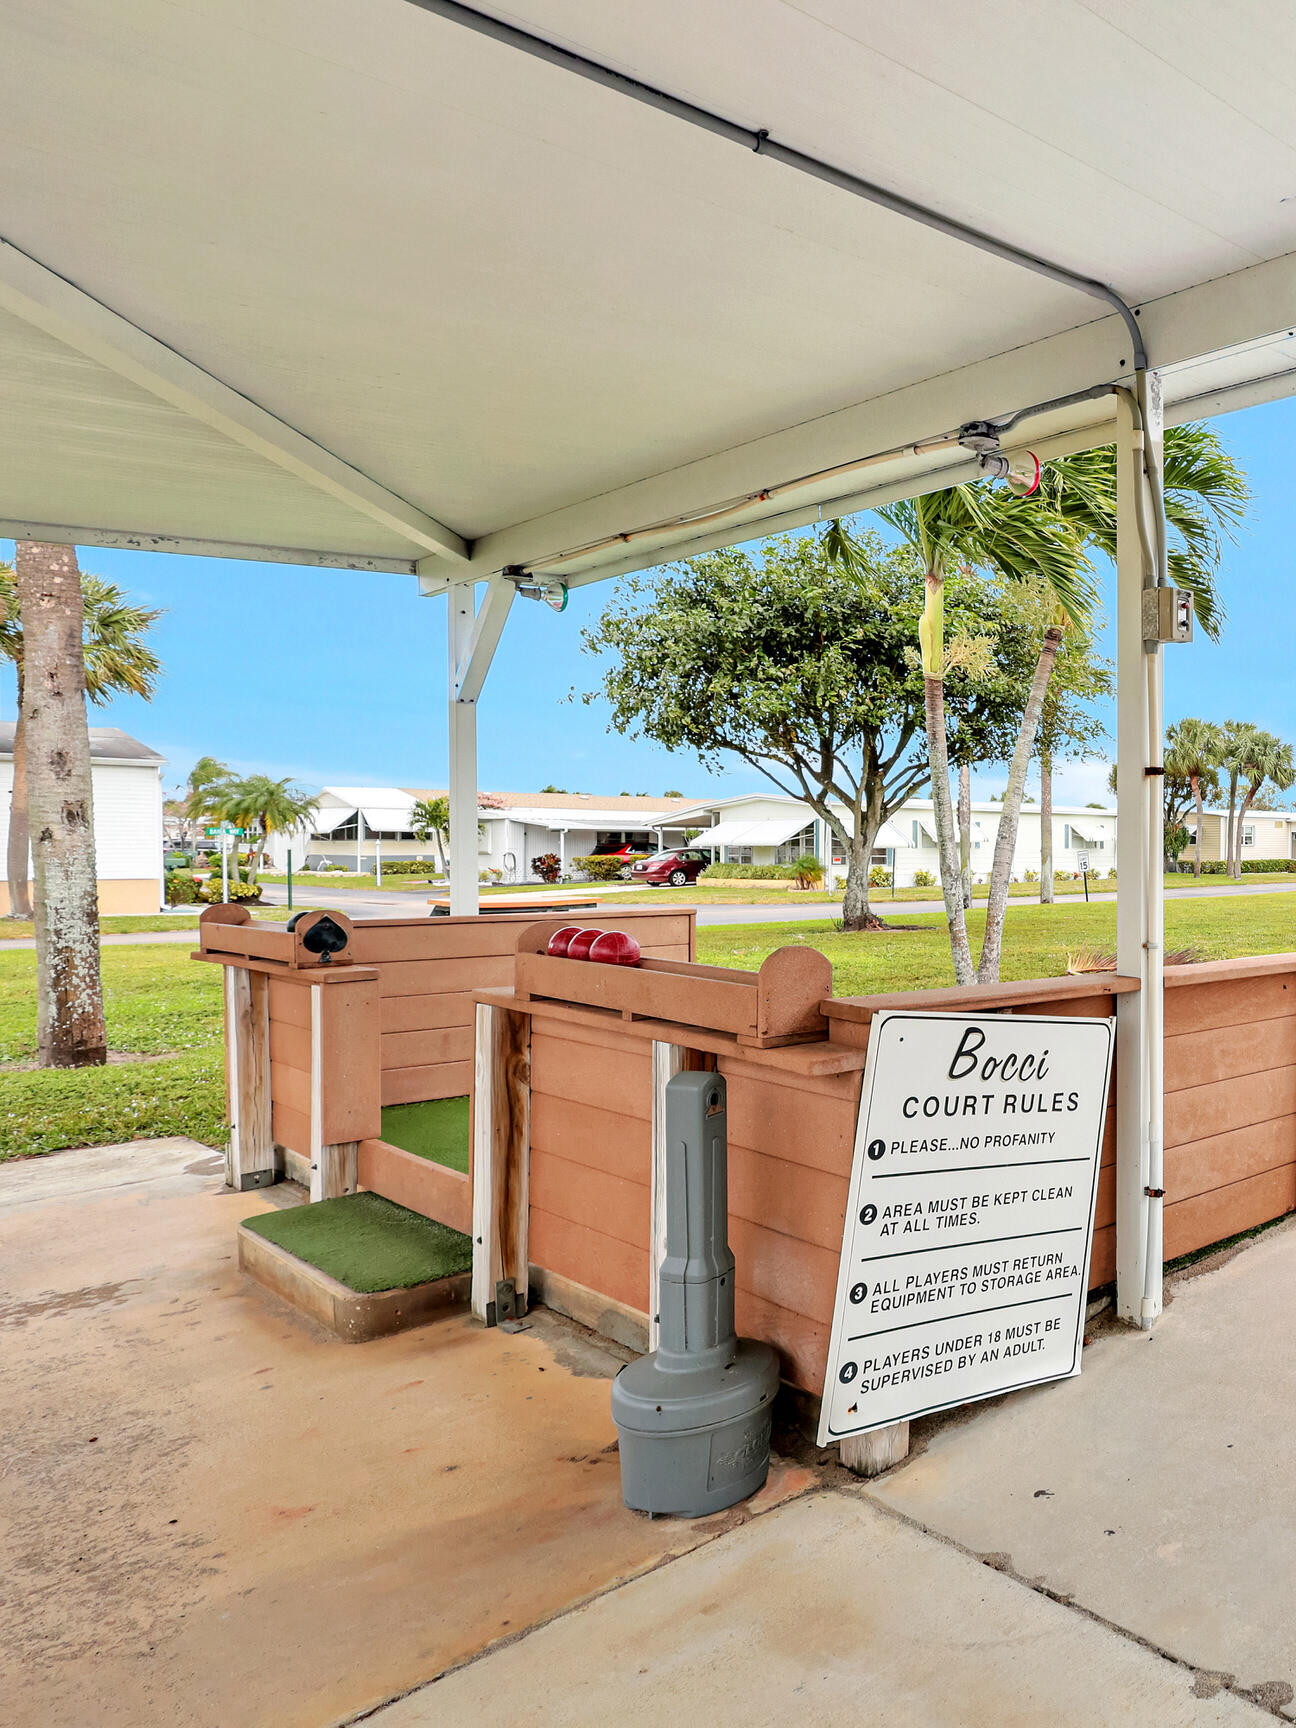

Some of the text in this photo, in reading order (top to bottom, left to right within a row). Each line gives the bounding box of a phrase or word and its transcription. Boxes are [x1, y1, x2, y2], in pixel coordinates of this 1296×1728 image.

[1080, 861, 1088, 870] 15
[948, 1027, 1049, 1081] Bocci
[903, 1092, 1079, 1118] COURT RULES
[984, 1132, 1055, 1148] PROFANITY
[882, 1202, 922, 1219] AREA
[928, 1197, 968, 1213] MUST
[972, 1194, 989, 1208] BE
[994, 1190, 1028, 1206] KEPT
[1032, 1186, 1073, 1201] CLEAN
[880, 1212, 980, 1237] AT ALL TIMES.
[871, 1265, 1080, 1313] EQUIPMENT TO STORAGE AREA.
[872, 1279, 900, 1296] ALL
[906, 1267, 968, 1289] PLAYERS
[972, 1260, 1009, 1278] MUST
[1013, 1252, 1063, 1271] RETURN
[863, 1346, 930, 1374] PLAYERS
[935, 1334, 982, 1356] UNDER
[988, 1330, 1001, 1344] 18
[1005, 1322, 1041, 1340] MUST
[1045, 1318, 1061, 1332] BE
[860, 1338, 1045, 1394] SUPERVISED BY AN ADULT.
